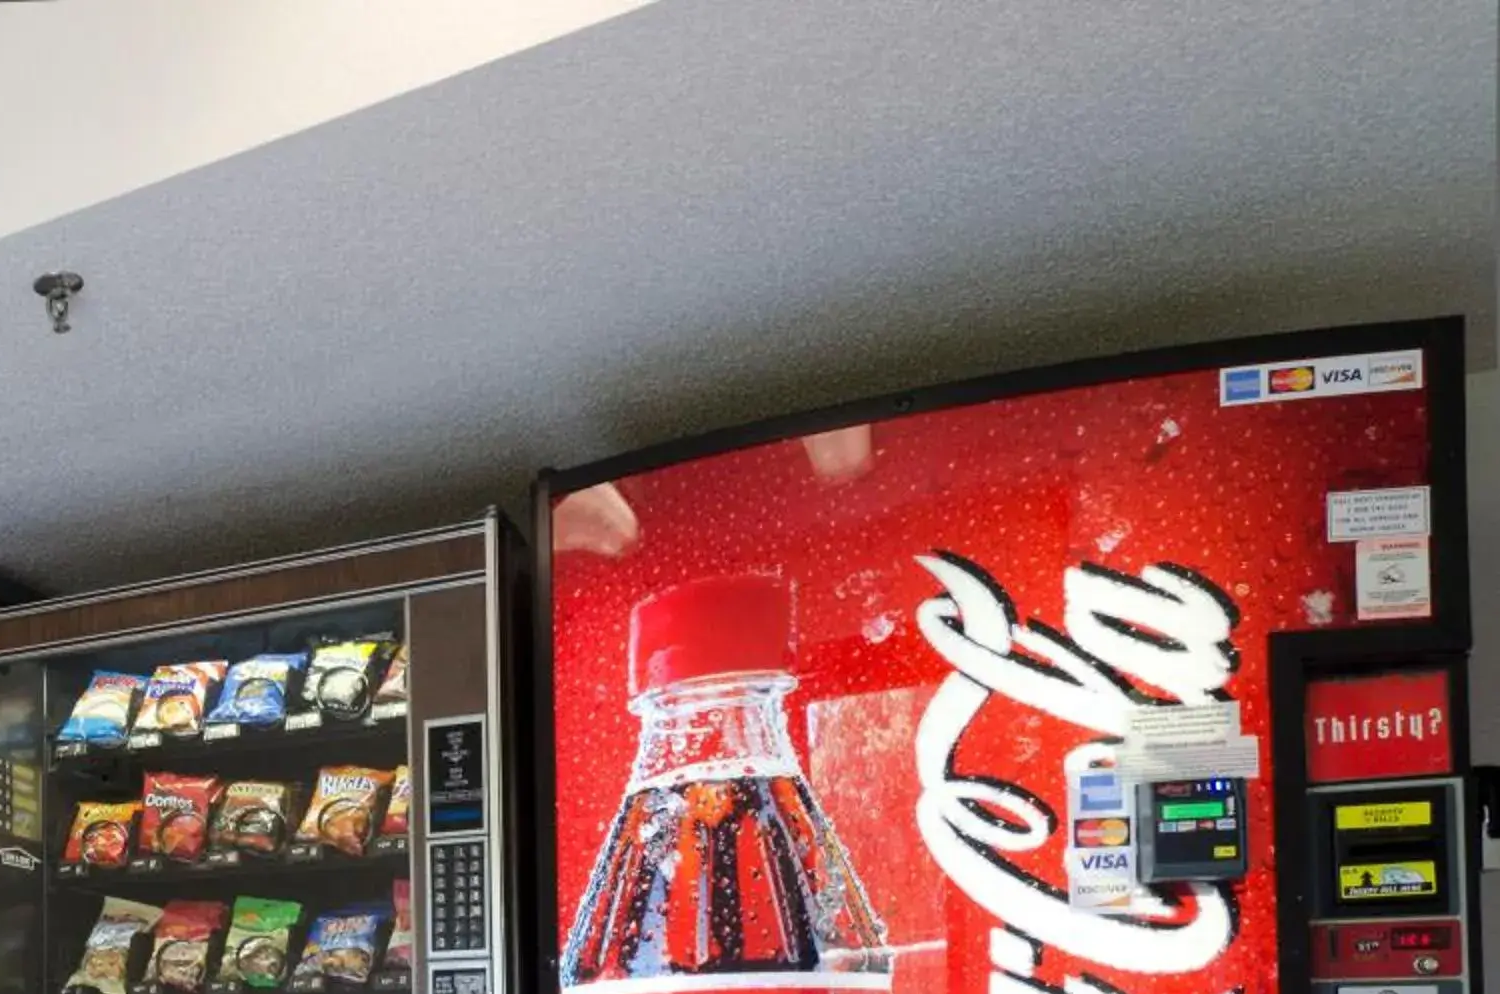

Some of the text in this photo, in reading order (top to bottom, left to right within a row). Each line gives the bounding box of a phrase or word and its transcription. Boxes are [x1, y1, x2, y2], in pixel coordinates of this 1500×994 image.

[1321, 367, 1362, 384] VISA
[1314, 707, 1443, 745] Thirsty?
[1081, 854, 1128, 870] VISA
